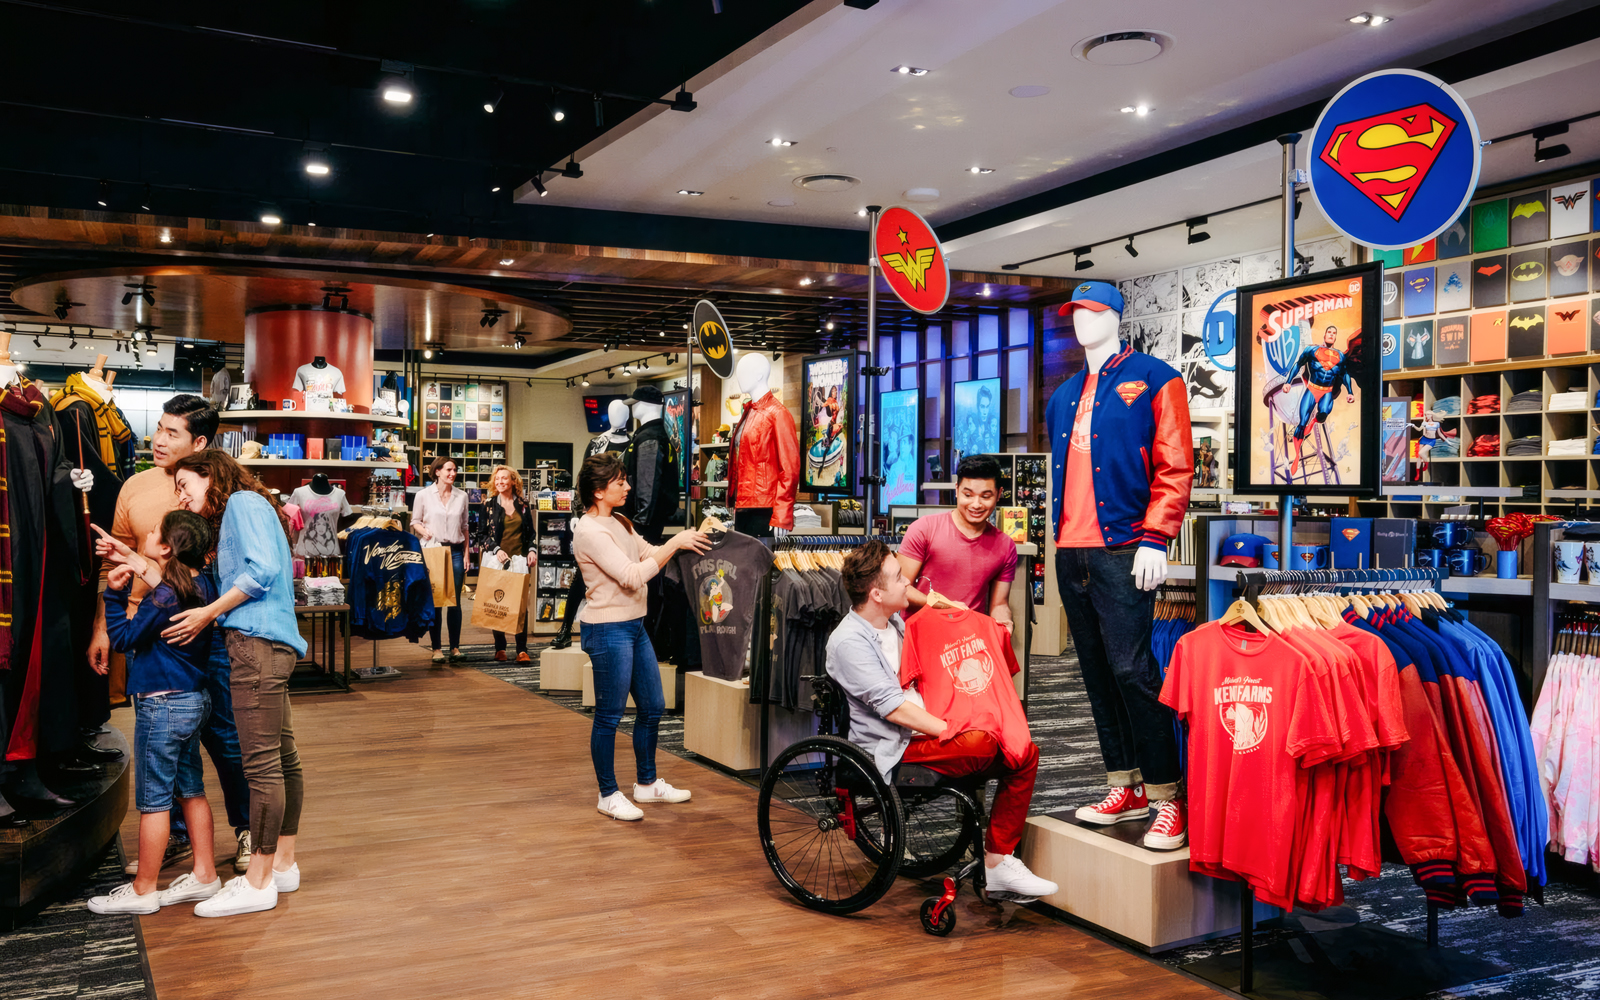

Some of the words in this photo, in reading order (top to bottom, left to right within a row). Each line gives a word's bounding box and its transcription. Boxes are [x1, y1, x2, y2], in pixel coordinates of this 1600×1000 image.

[1350, 283, 1361, 293] DC
[1267, 297, 1353, 343] SUPERMAN
[1440, 332, 1464, 342] SWIM
[692, 558, 715, 580] THIS
[716, 559, 738, 580] GIRL
[716, 626, 737, 635] ROUGH
[940, 648, 960, 668] KENT
[960, 638, 987, 659] FARM
